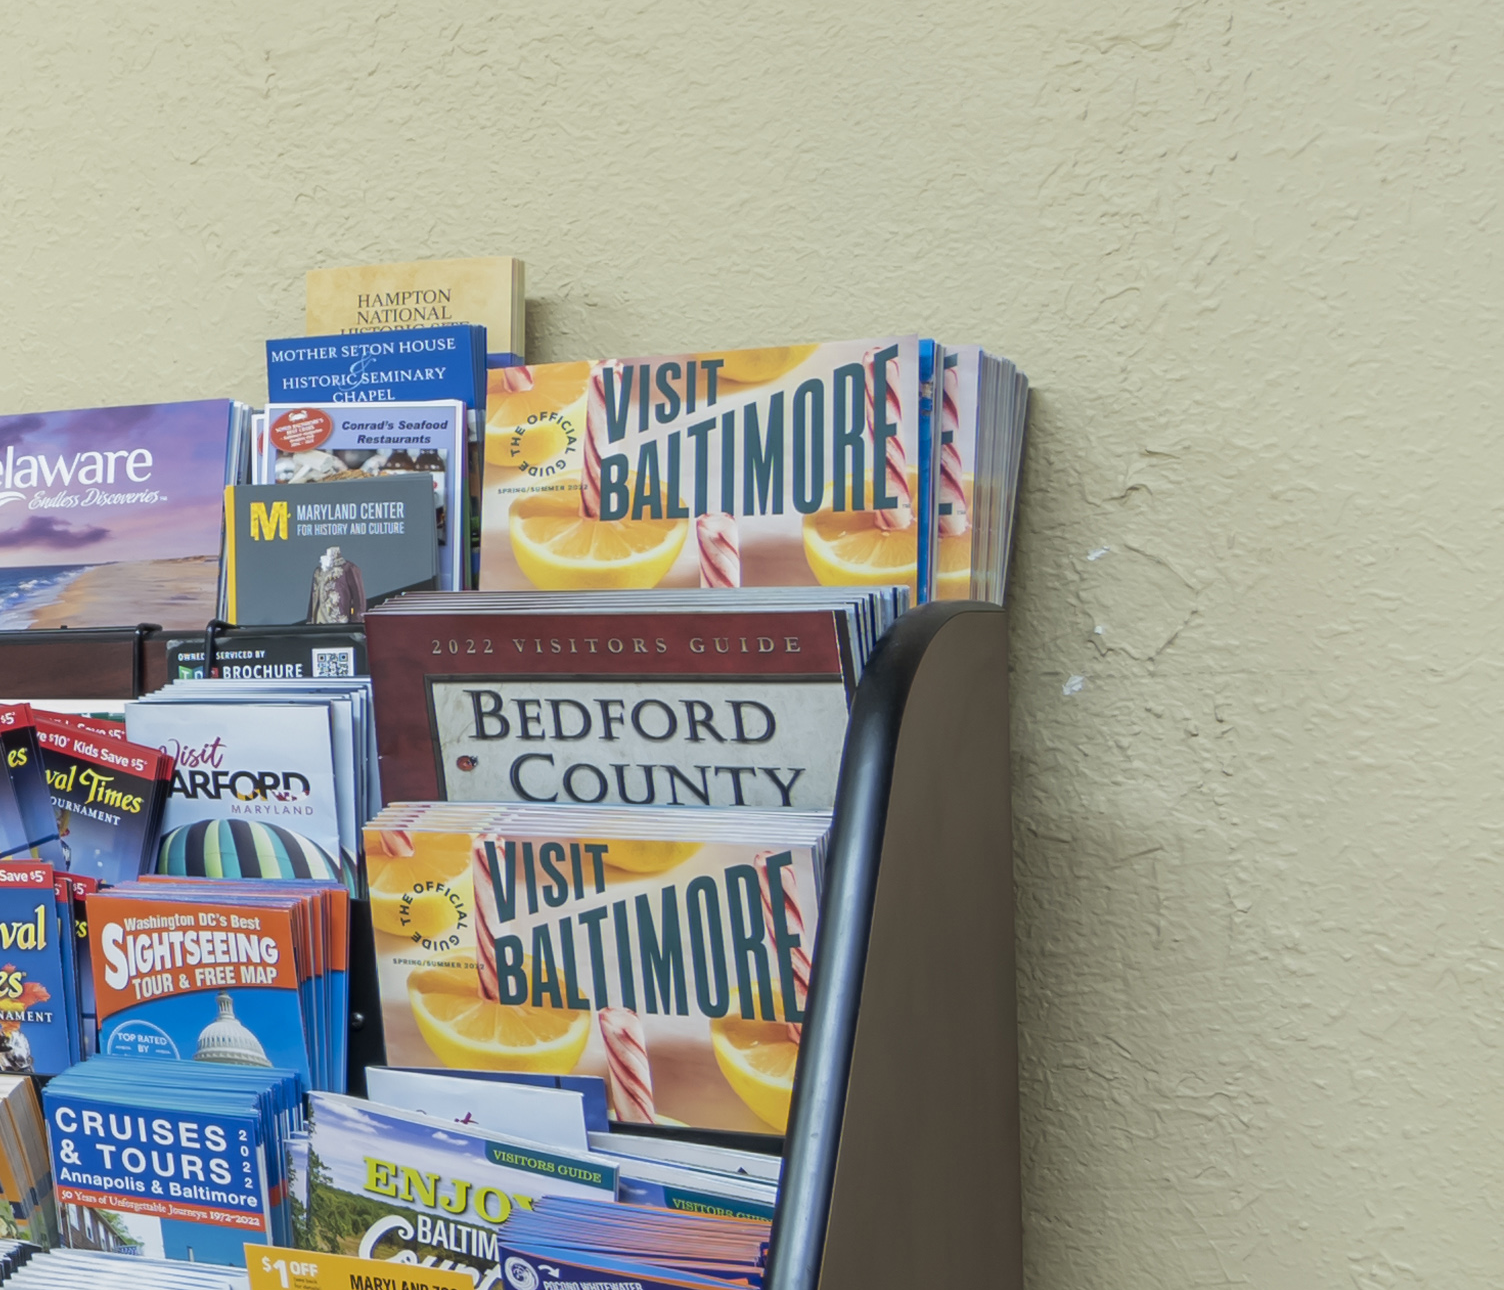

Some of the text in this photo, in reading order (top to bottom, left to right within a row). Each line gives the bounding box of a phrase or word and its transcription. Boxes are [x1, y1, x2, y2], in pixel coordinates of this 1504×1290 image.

[272, 339, 456, 363] MOTHER SETON HOUSE
[282, 367, 446, 389] HISTORIC SEMINARY
[333, 389, 395, 403] CHAPEL
[602, 358, 724, 444] VISIT
[342, 420, 448, 431] Conrad's Seafood
[599, 343, 899, 522] BALTIMORE
[357, 434, 431, 444] Restaurants
[510, 411, 576, 477] THE OFFICIAL GUIDE
[28, 487, 160, 510] Endless Discoveries
[297, 502, 404, 521] MARYLAND CENTER
[297, 522, 405, 535] FOR HISTORY AND CULTURE
[432, 637, 801, 655] 2022 VISITORS GUIDE
[223, 664, 303, 678] BROCHURE
[463, 689, 777, 744] BEDFORD
[509, 753, 806, 807] COUNTY
[231, 805, 314, 815] MARYLAND
[30, 869, 45, 882] $5
[124, 913, 260, 931] Washington DC's Best
[101, 923, 279, 991] SIGHTSEEING
[131, 966, 277, 1000] TOUR & FREE MAP
[55, 1107, 227, 1152] CRUISES
[60, 1139, 232, 1184] & TOURS
[60, 1167, 258, 1207] Annapolis & Baltimore
[262, 1256, 288, 1289] $1
[289, 1261, 318, 1278] OFF
